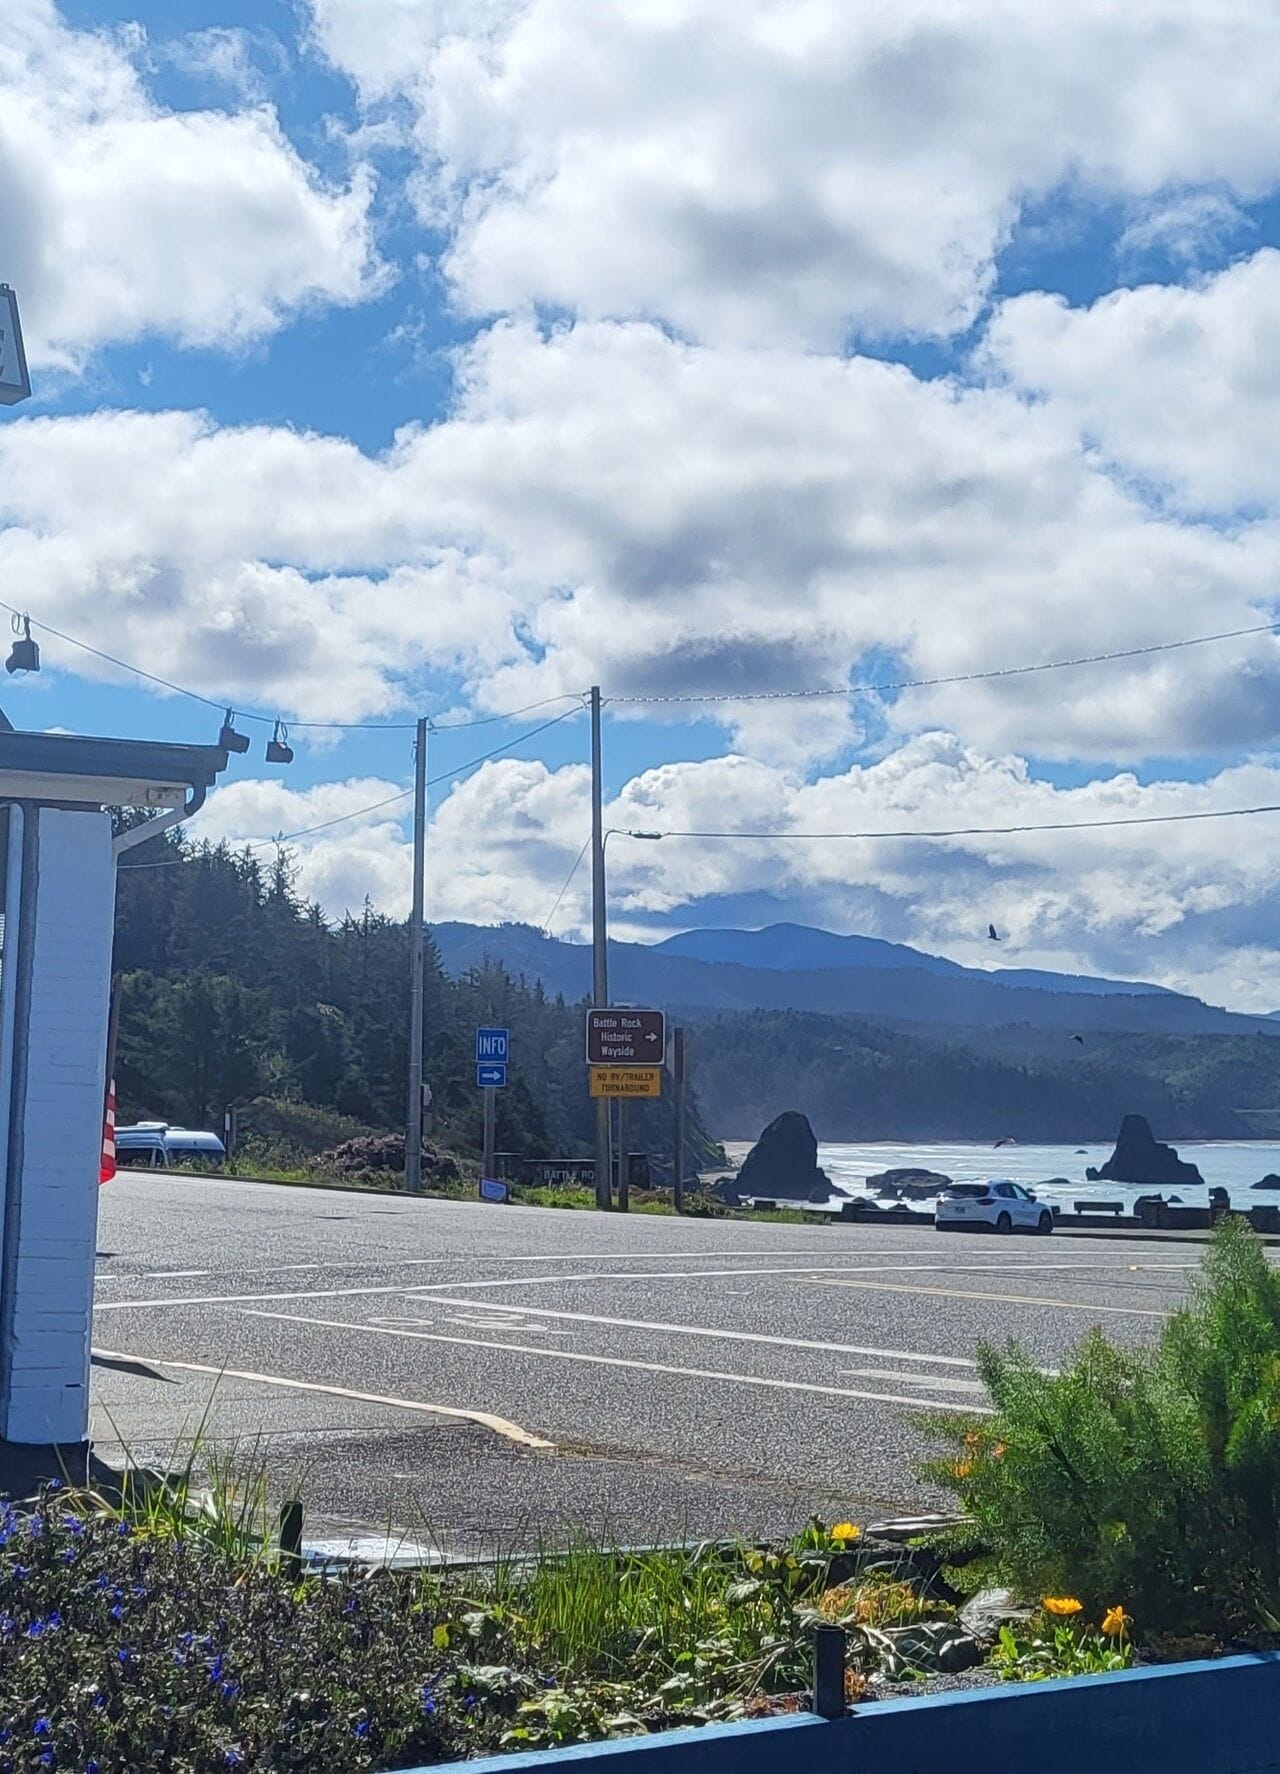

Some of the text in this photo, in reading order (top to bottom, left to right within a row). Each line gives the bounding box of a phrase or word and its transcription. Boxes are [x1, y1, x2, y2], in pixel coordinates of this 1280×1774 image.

[593, 1018, 642, 1028] Battle Rock
[601, 1031, 632, 1042] Historic
[479, 1037, 506, 1055] INFO
[601, 1046, 634, 1057] Wayside
[596, 1073, 654, 1081] NO RV/TRAILER
[601, 1084, 650, 1093] TURNAROUND
[544, 1170, 576, 1180] BATTLE
